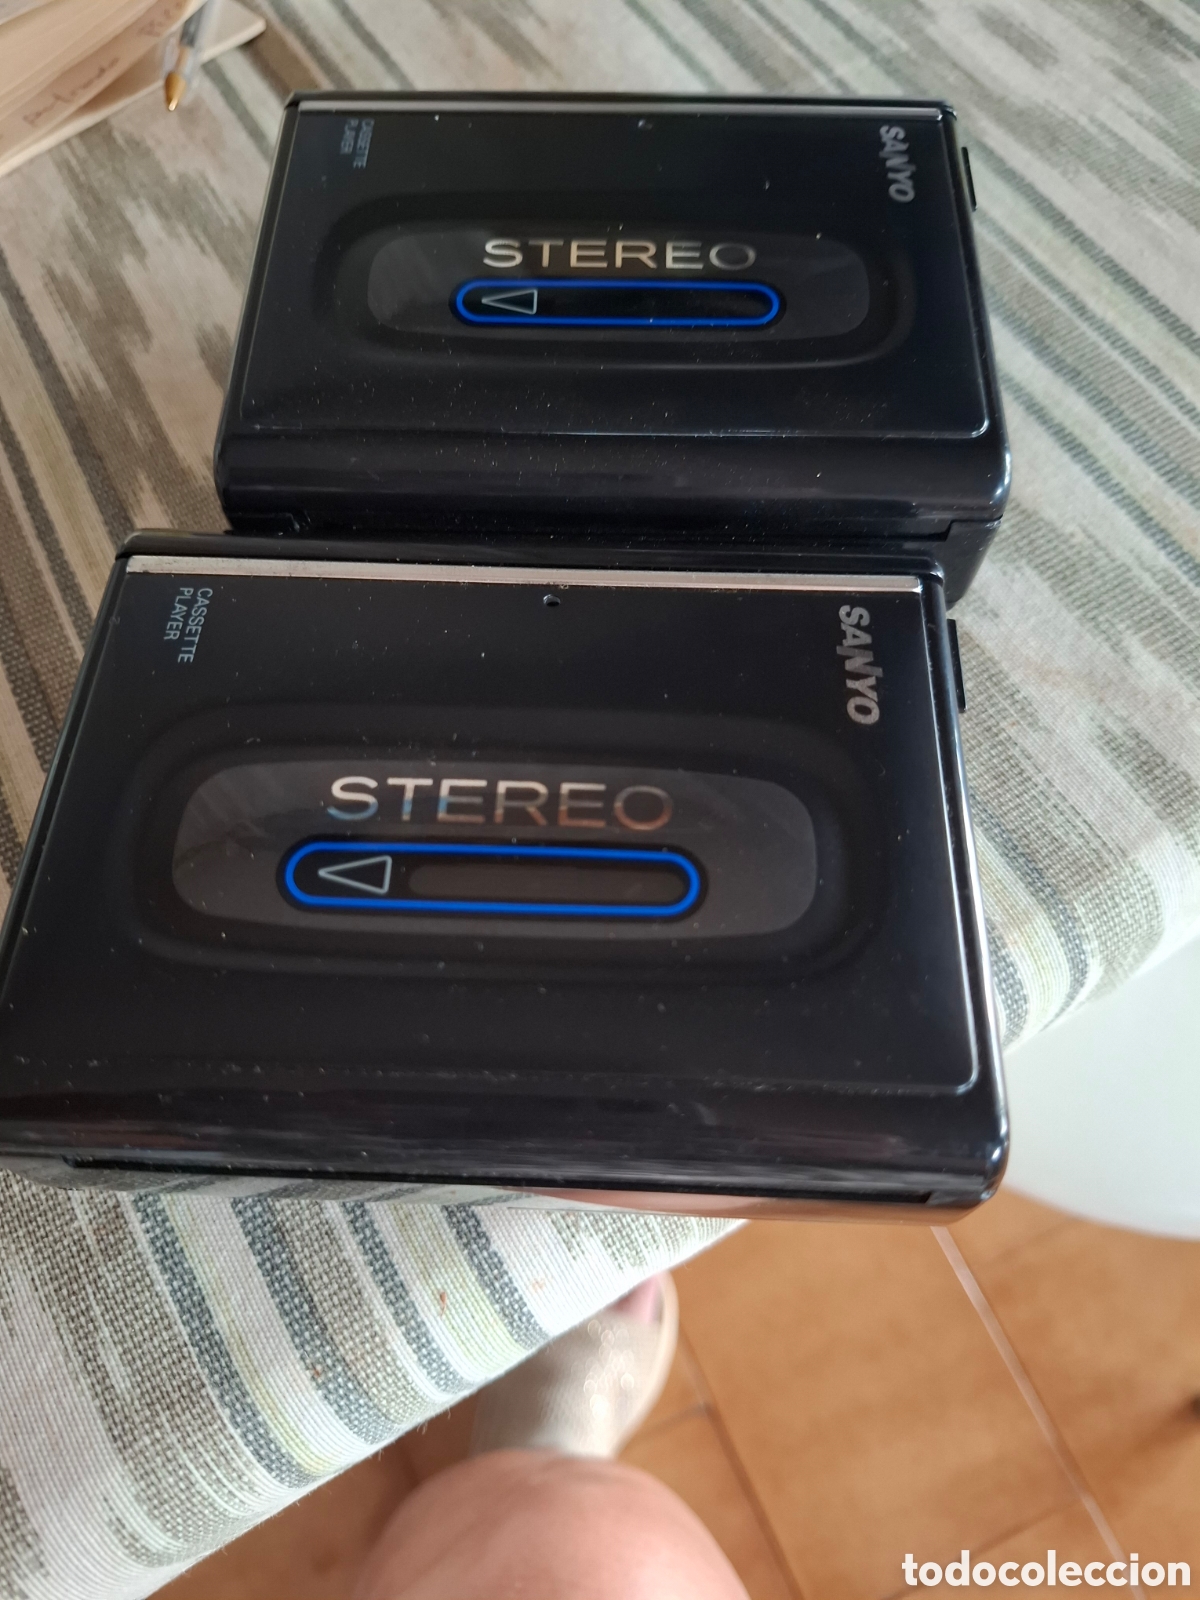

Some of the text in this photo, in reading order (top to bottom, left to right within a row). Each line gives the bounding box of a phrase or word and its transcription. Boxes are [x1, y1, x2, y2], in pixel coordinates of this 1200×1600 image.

[879, 125, 916, 203] SANYO
[483, 238, 757, 271] STEREO
[163, 587, 194, 640] PLAYER
[177, 587, 213, 663] CASSETTE
[836, 605, 883, 725] SANYO
[326, 776, 674, 831] STEREO
